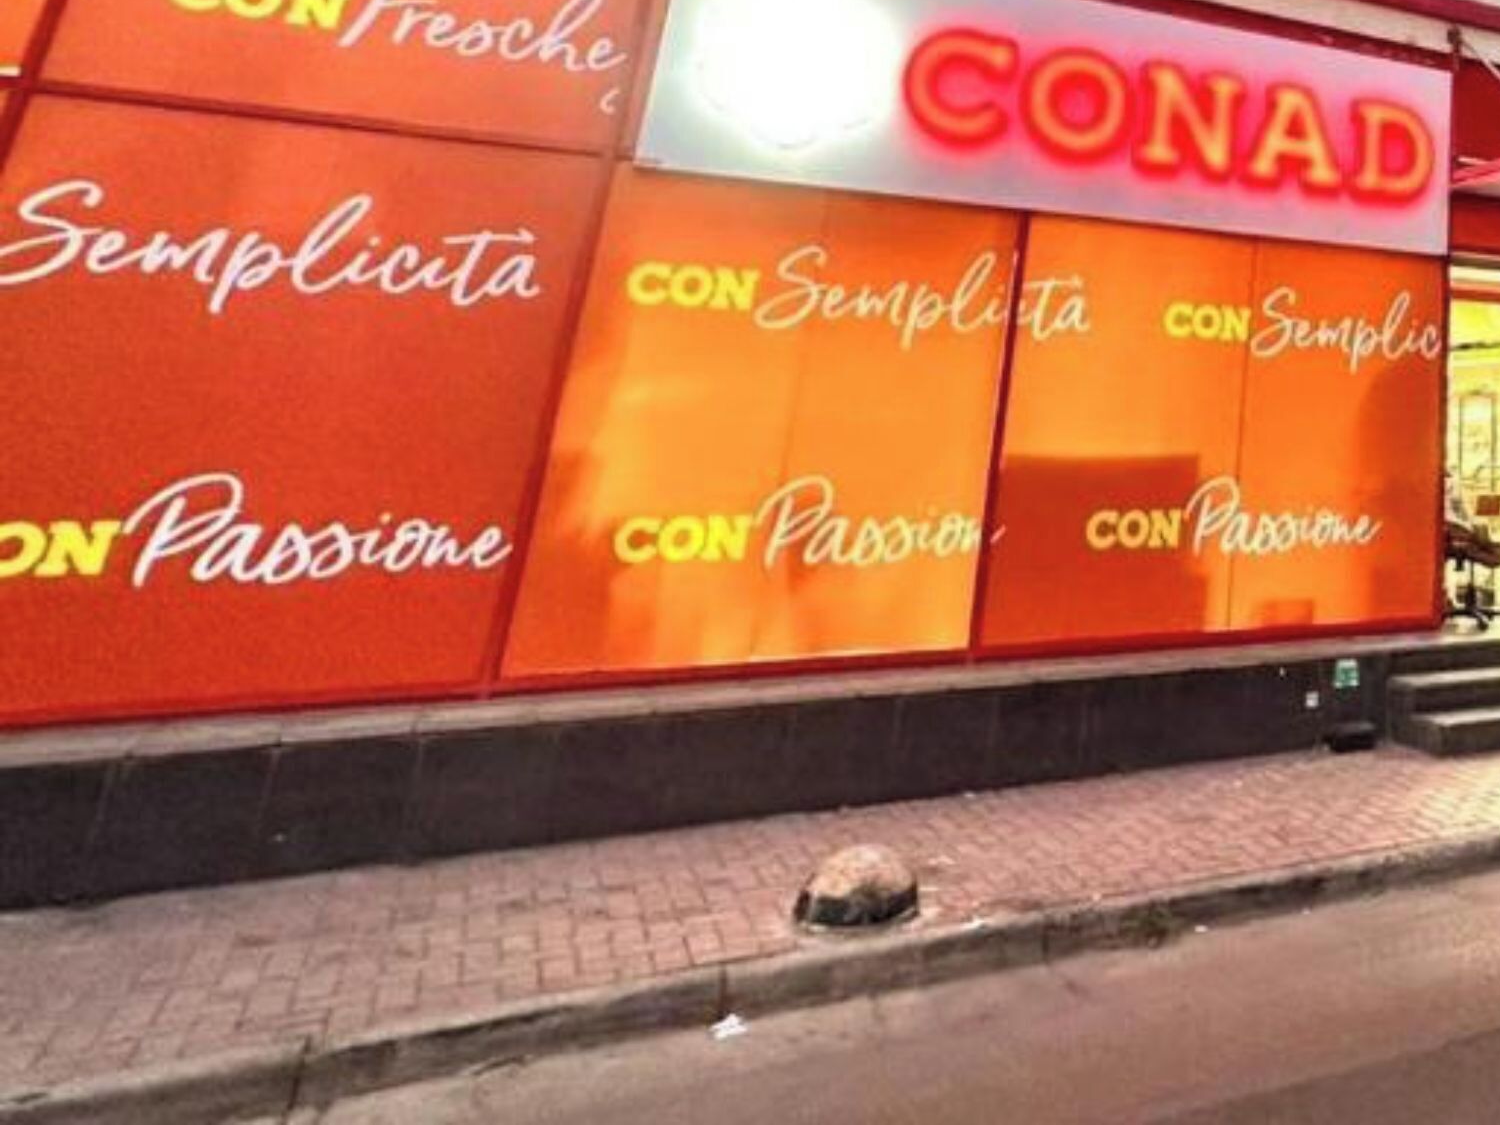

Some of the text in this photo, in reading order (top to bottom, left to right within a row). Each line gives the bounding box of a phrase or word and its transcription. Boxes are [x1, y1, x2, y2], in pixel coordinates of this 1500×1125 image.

[905, 27, 1436, 207] CONAD
[627, 261, 760, 310] CON
[1164, 302, 1251, 342] CON
[123, 472, 513, 588] Passione
[614, 515, 756, 564] CON
[1086, 476, 1382, 557] CON Passione
